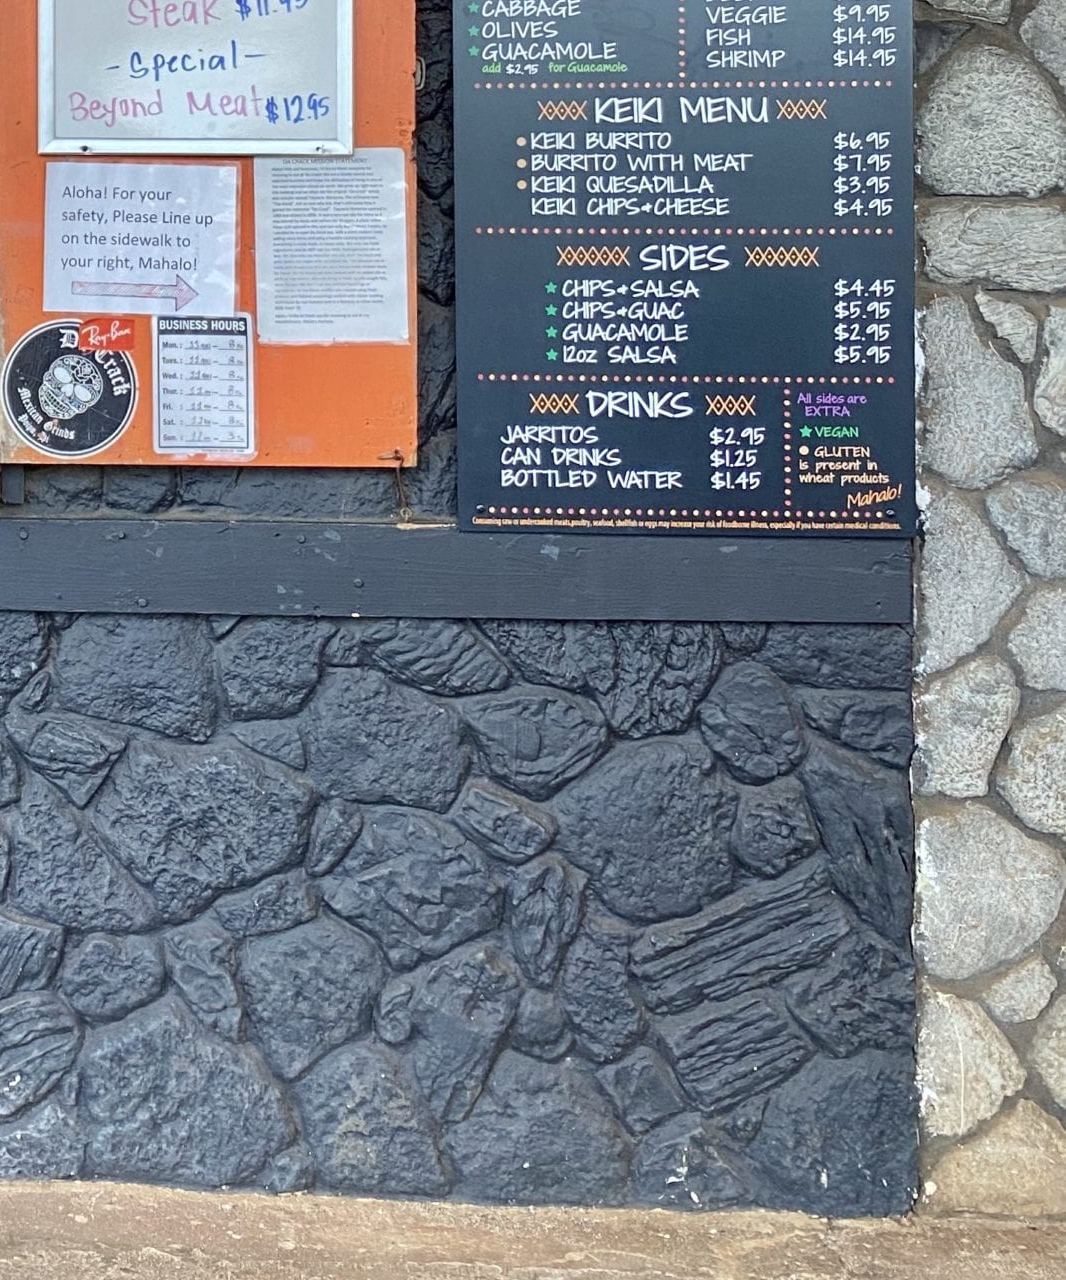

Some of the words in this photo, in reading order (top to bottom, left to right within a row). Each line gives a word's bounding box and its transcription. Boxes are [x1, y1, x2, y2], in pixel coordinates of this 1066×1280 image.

[482, 0, 581, 17] CABBAGE
[706, 6, 787, 25] VEGGIE
[833, 5, 891, 23] $9.95
[482, 21, 558, 38] OLIVES
[706, 29, 751, 46] FISH
[833, 27, 897, 45] $14.95
[482, 41, 617, 62] GUACAMOLE
[706, 50, 785, 68] SHRIMP
[833, 49, 897, 67] $14.95
[567, 61, 628, 72] Guacamole
[69, 89, 163, 128] Beyond
[187, 85, 262, 117] Meat
[265, 96, 330, 123] $12.95
[595, 97, 662, 123] KEIKI
[680, 96, 768, 123] MENU
[531, 133, 574, 150] KEIKI
[586, 132, 671, 150] BURRITO
[834, 132, 891, 150] $6.95
[531, 154, 616, 171] BURRITO
[629, 154, 684, 171] WITH
[695, 154, 753, 171] MEAT
[833, 154, 892, 172] $7.95
[531, 176, 575, 193] KEIKI
[586, 176, 713, 194] QUESADILLA
[834, 176, 891, 194] $3.95
[62, 186, 107, 200] Aloha!
[112, 187, 134, 200] For
[140, 190, 171, 203] your
[531, 198, 575, 215] KEIKI
[834, 198, 893, 215] $4.95
[61, 209, 108, 225] safety,
[113, 210, 157, 224] Please
[162, 211, 191, 224] Line
[196, 216, 213, 227] up
[61, 235, 80, 245] on
[84, 233, 106, 245] the
[111, 233, 172, 247] sidewalk
[176, 236, 191, 247] to
[61, 257, 92, 271] your
[97, 255, 133, 272] right,
[139, 258, 197, 271] Mahalo!
[639, 245, 730, 271] SIDES
[835, 279, 895, 297] $4.45
[834, 301, 893, 319] $5.95
[81, 321, 131, 346] Ray-Ban
[159, 320, 207, 330] BUSINESS
[211, 320, 245, 331] HOURS
[562, 324, 688, 342] GUACAMOLE
[834, 324, 891, 341] $2.95
[608, 345, 676, 364] SALSA
[834, 346, 892, 363] $5.95
[585, 390, 693, 418] DRINKS
[816, 393, 844, 403] sides
[805, 407, 850, 416] EXTRA
[500, 425, 598, 445] JARRITOS
[709, 427, 765, 446] $2.95
[815, 427, 859, 437] VEGAN
[501, 447, 540, 466] CAN
[552, 448, 622, 466] DRINKS
[710, 449, 757, 468] $1.25
[814, 446, 870, 458] GLUTEN
[816, 460, 861, 473] present
[501, 470, 596, 488] BOTTLED
[608, 471, 683, 489] WATER
[711, 471, 762, 490] $1.45
[799, 473, 835, 483] wheat
[841, 473, 889, 486] products
